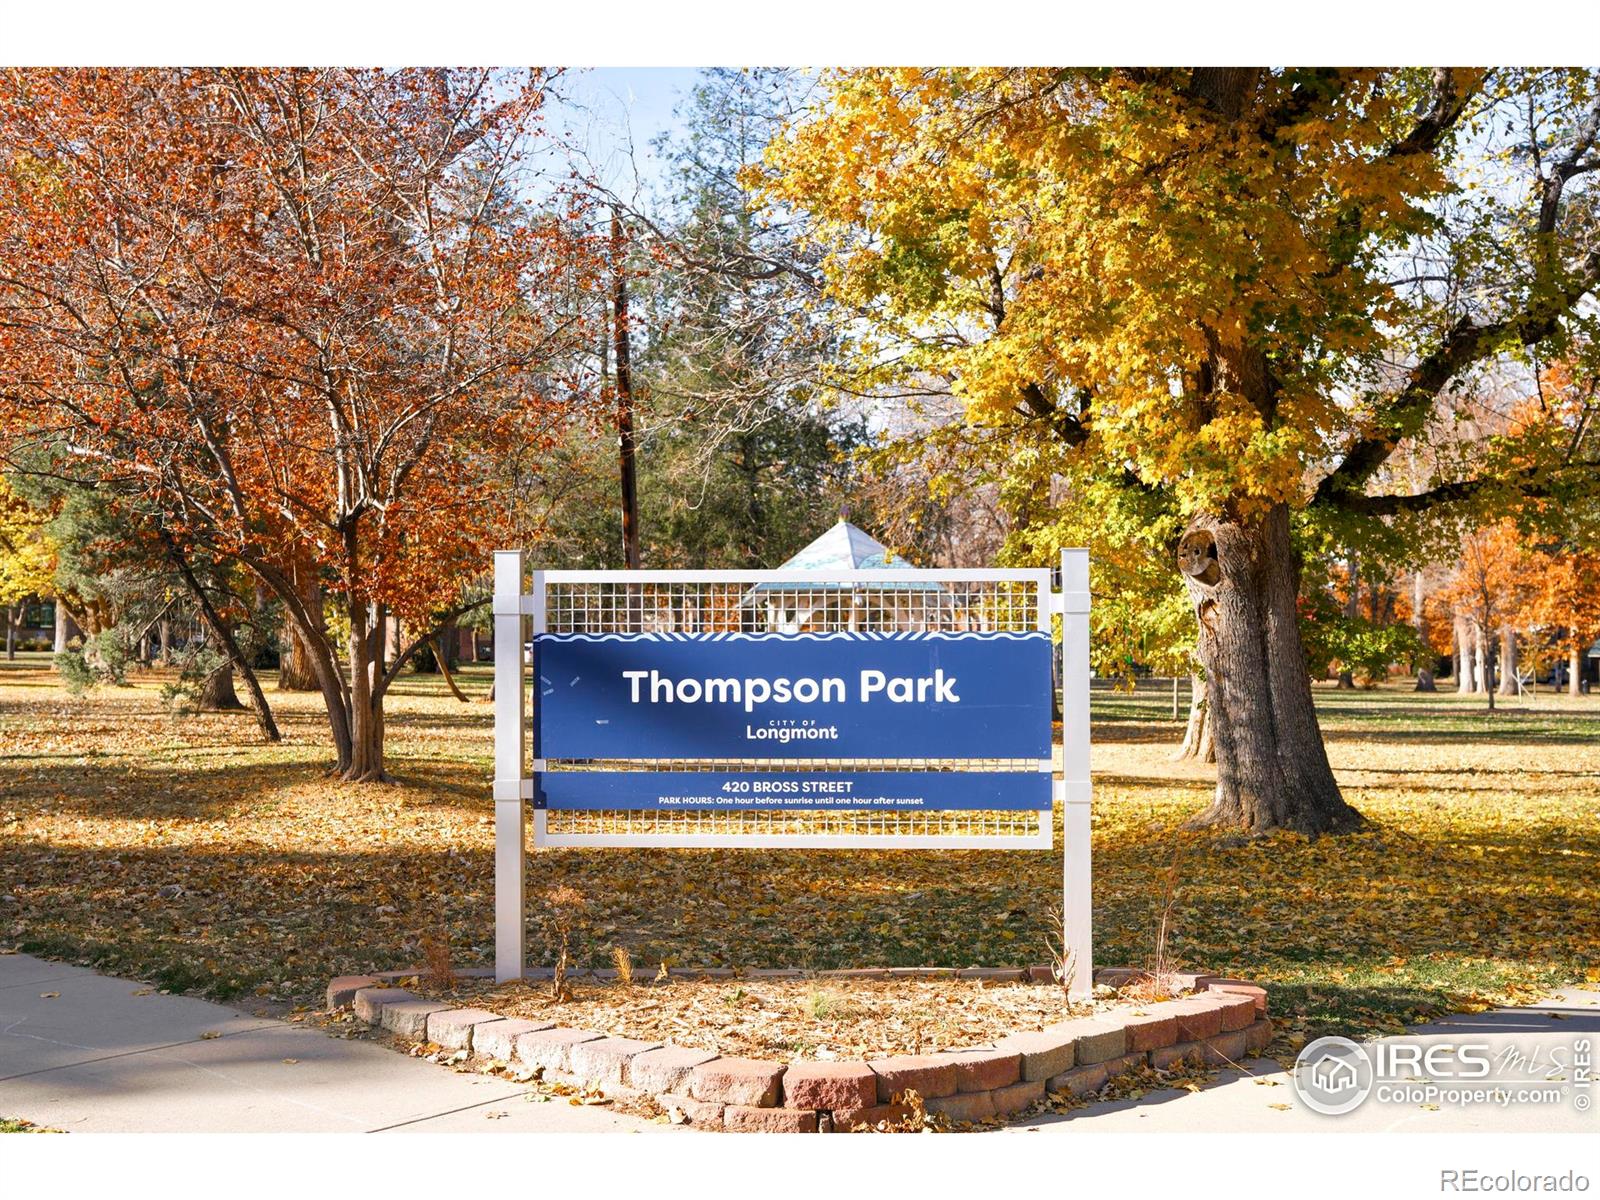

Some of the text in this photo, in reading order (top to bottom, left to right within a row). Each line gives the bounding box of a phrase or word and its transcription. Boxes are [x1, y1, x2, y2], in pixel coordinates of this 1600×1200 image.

[622, 668, 961, 713] Thompson Park
[746, 725, 839, 744] Longmont
[721, 781, 854, 793] 420 BROSS STREET
[658, 796, 924, 805] PARK HOURS: One hour before sunrise until one hour after sunset
